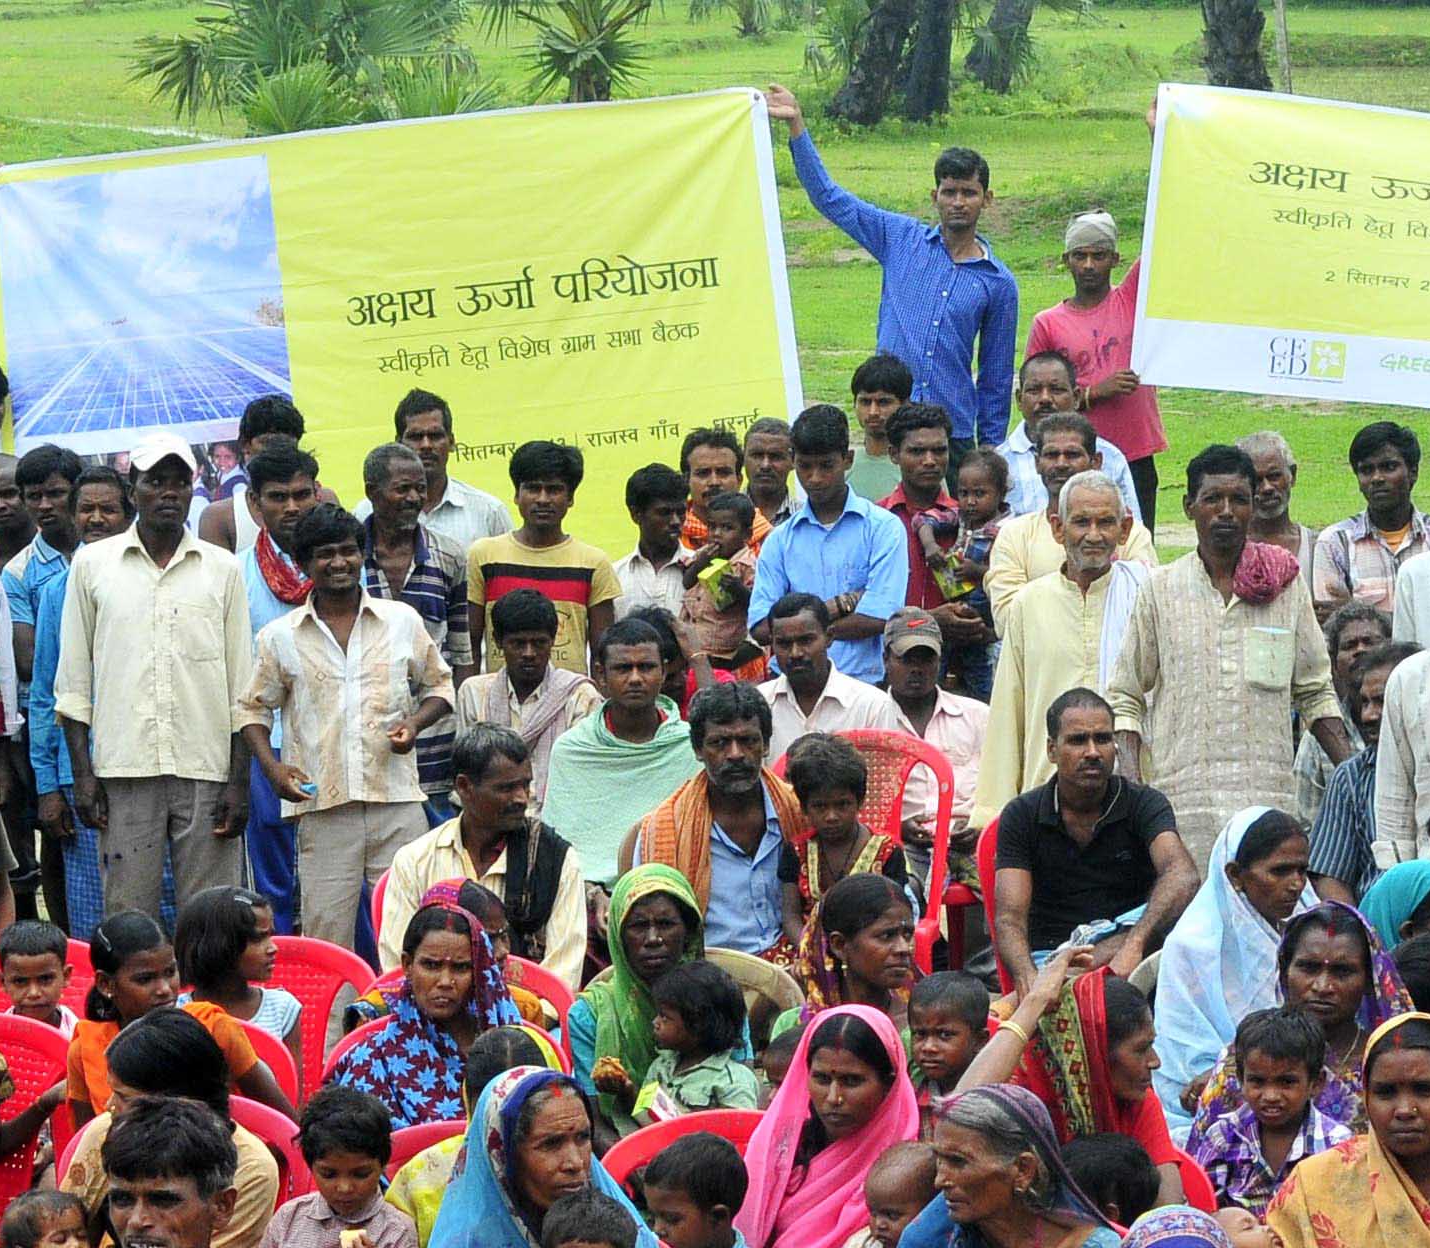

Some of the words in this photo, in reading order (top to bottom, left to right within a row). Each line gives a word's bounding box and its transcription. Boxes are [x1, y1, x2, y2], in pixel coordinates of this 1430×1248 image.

[1249, 161, 1351, 192] अक्षय
[1272, 207, 1352, 231] स्वीकृति
[346, 288, 437, 327] अक्षय
[455, 265, 536, 317] ऊर्जा
[551, 254, 721, 304] परियोजना
[1324, 270, 1336, 283] 2
[377, 344, 451, 377] स्वीकृति
[498, 335, 552, 361] विशेष
[560, 333, 597, 356] ग्राम
[605, 328, 643, 349] सभा
[651, 319, 700, 344] बैठक
[584, 428, 639, 449] राजस्व
[647, 418, 681, 441] गाँव
